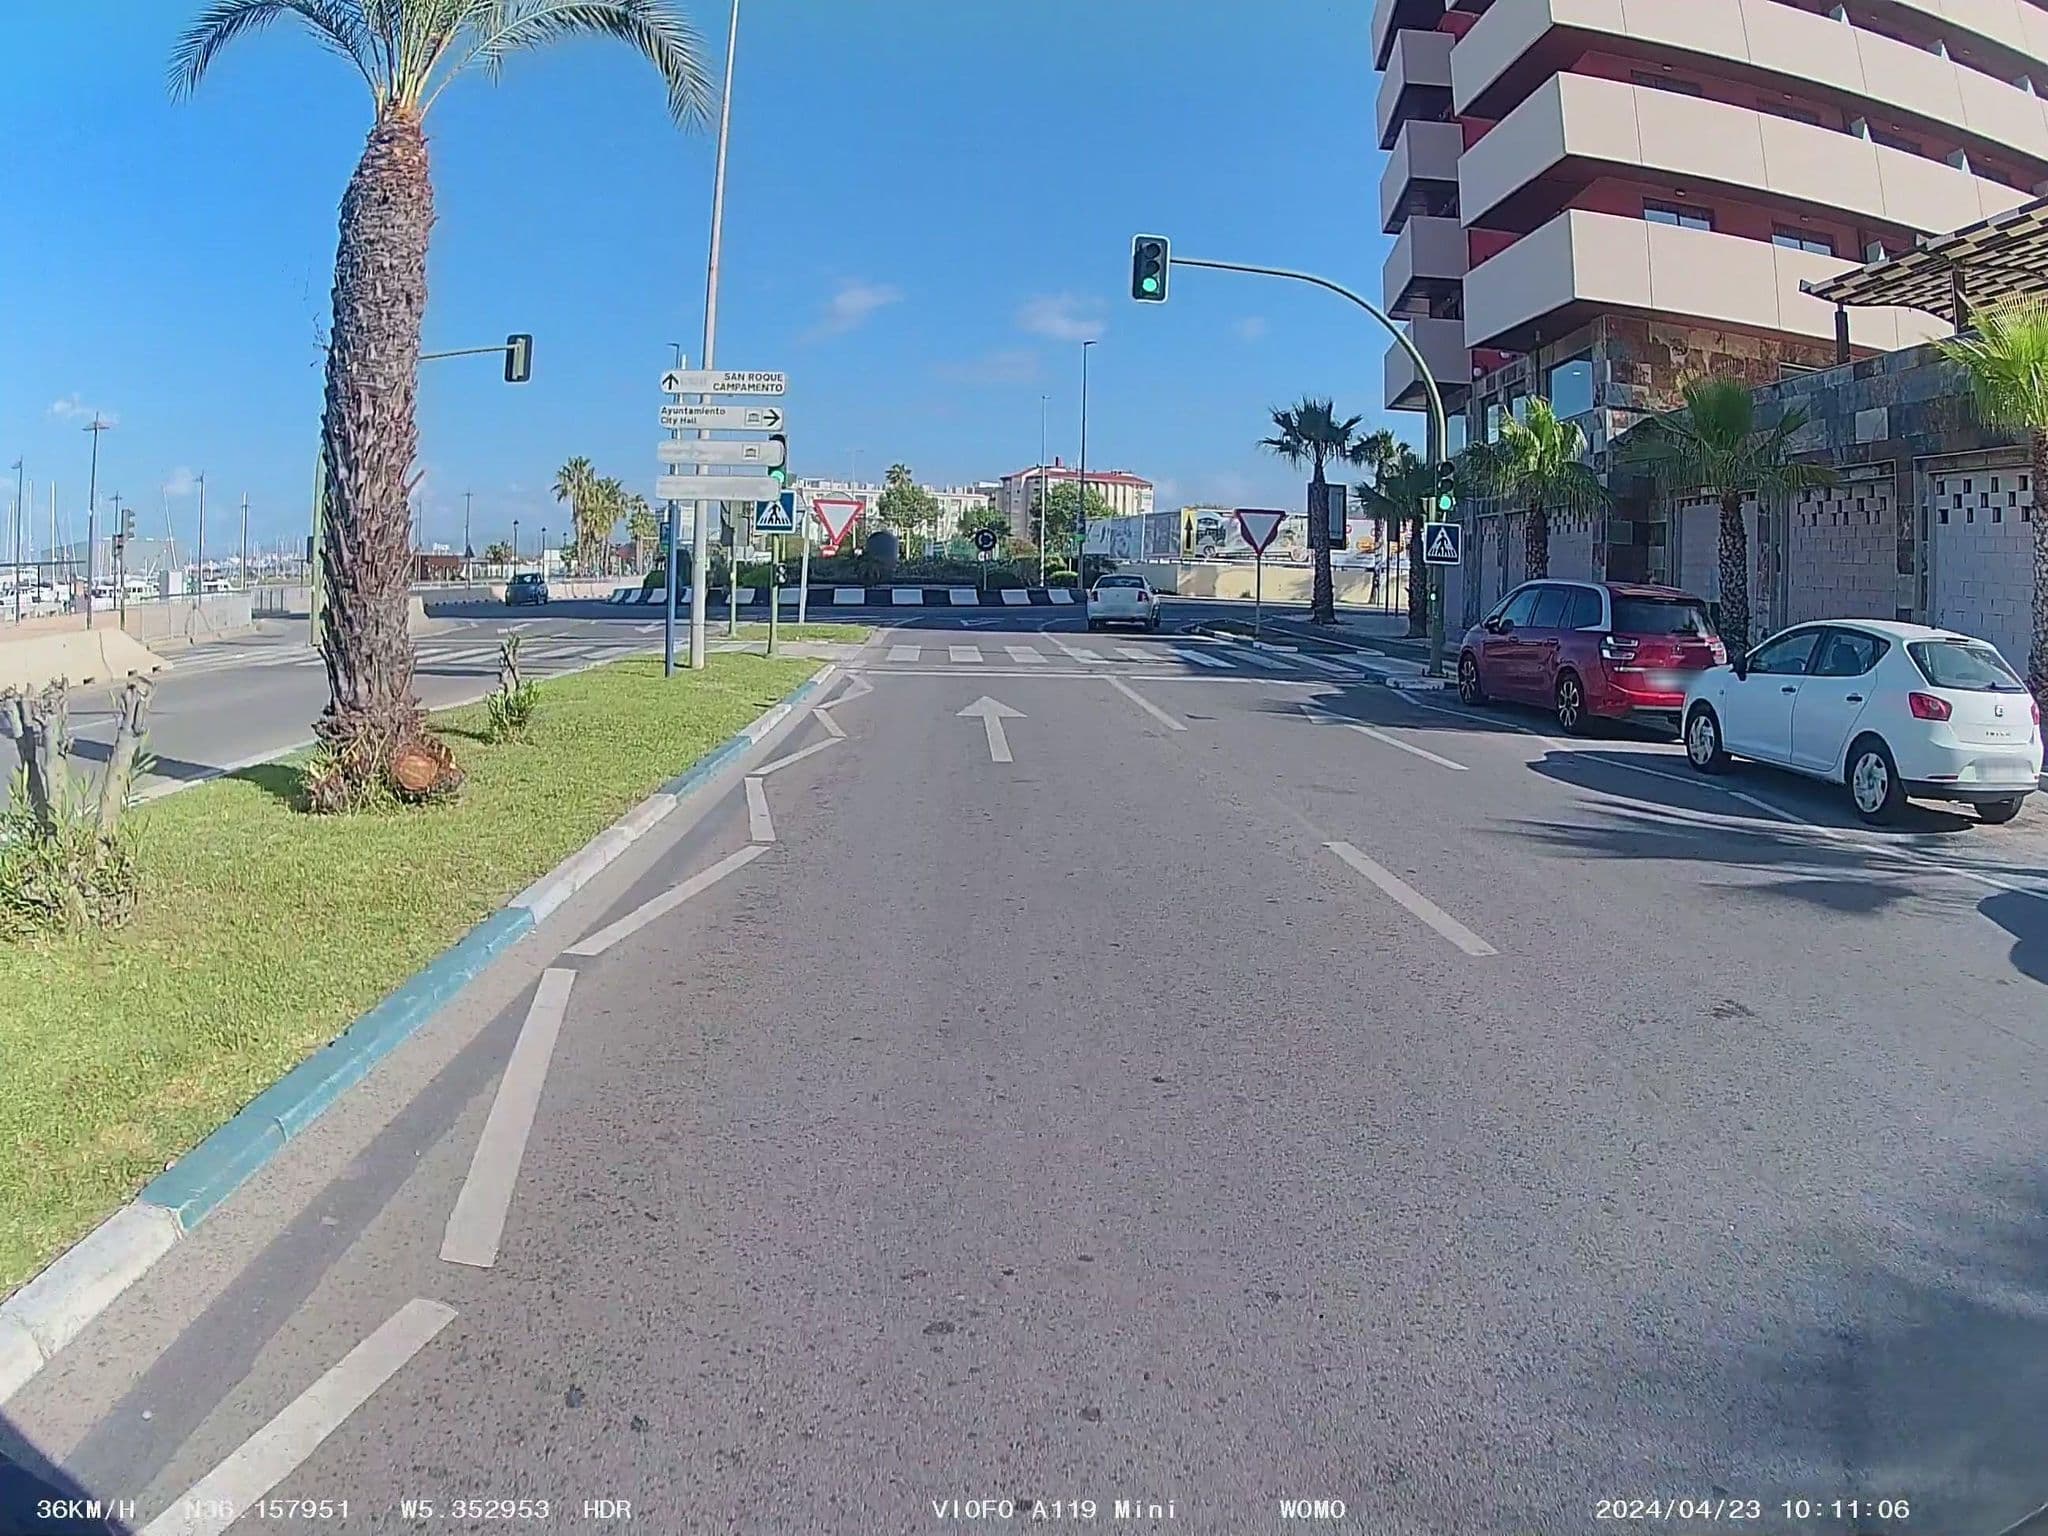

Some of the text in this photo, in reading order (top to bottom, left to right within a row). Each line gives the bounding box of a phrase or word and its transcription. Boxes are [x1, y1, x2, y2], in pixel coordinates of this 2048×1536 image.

[724, 372, 783, 382] SAN ROQUE
[712, 382, 783, 392] CAMPAMENTO
[661, 406, 726, 417] Ayuntamiento
[660, 416, 697, 425] City Hall
